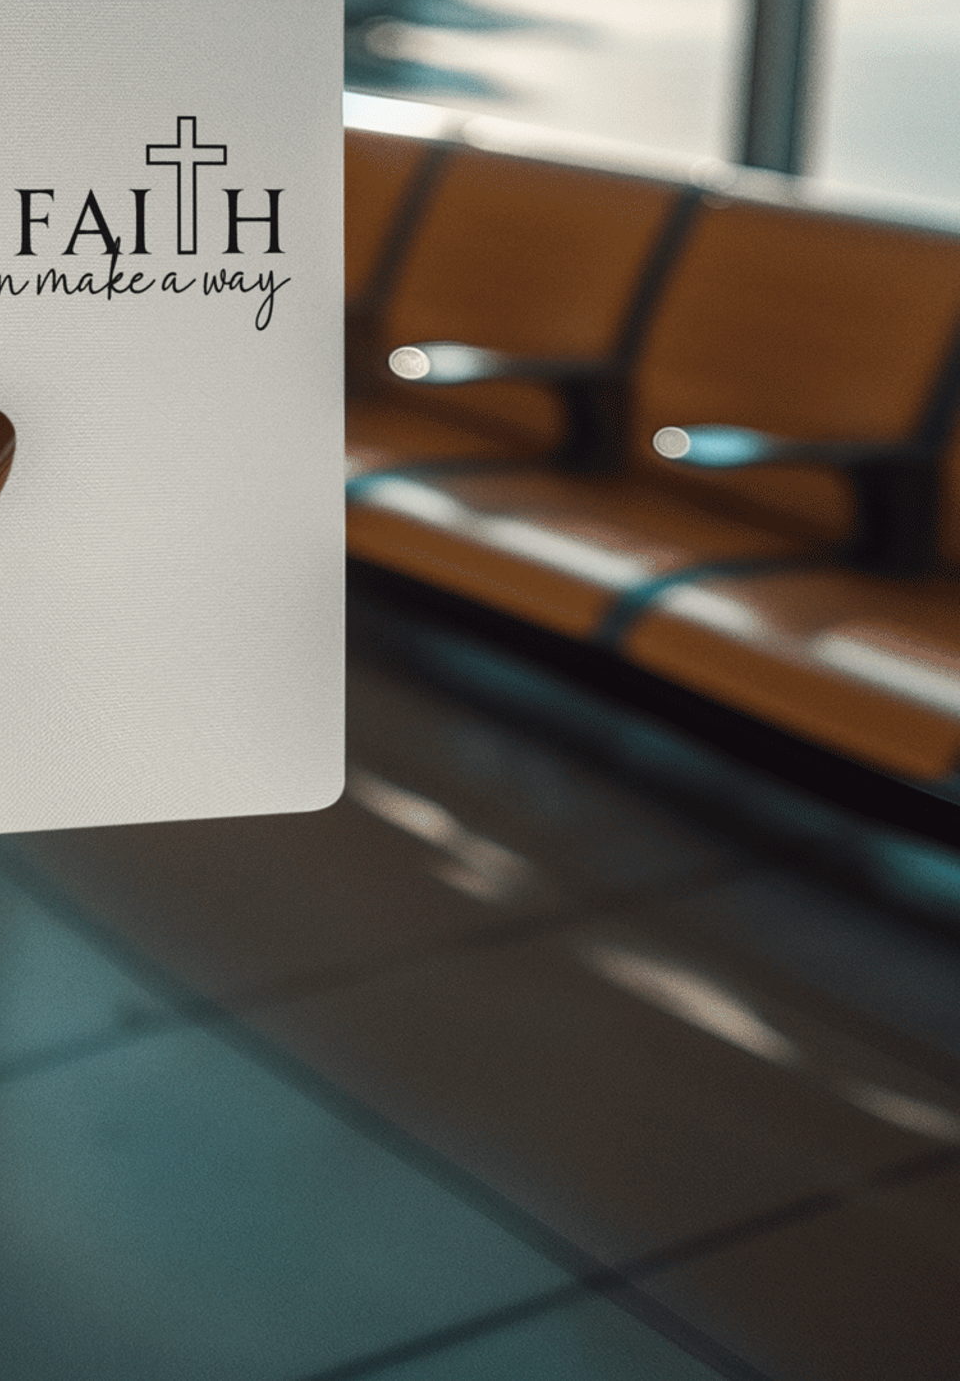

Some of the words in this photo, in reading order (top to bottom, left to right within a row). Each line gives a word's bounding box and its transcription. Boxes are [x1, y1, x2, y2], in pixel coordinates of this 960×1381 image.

[15, 115, 285, 257] FAITH
[36, 236, 156, 301] make
[161, 272, 197, 294] a
[203, 268, 292, 331] way
